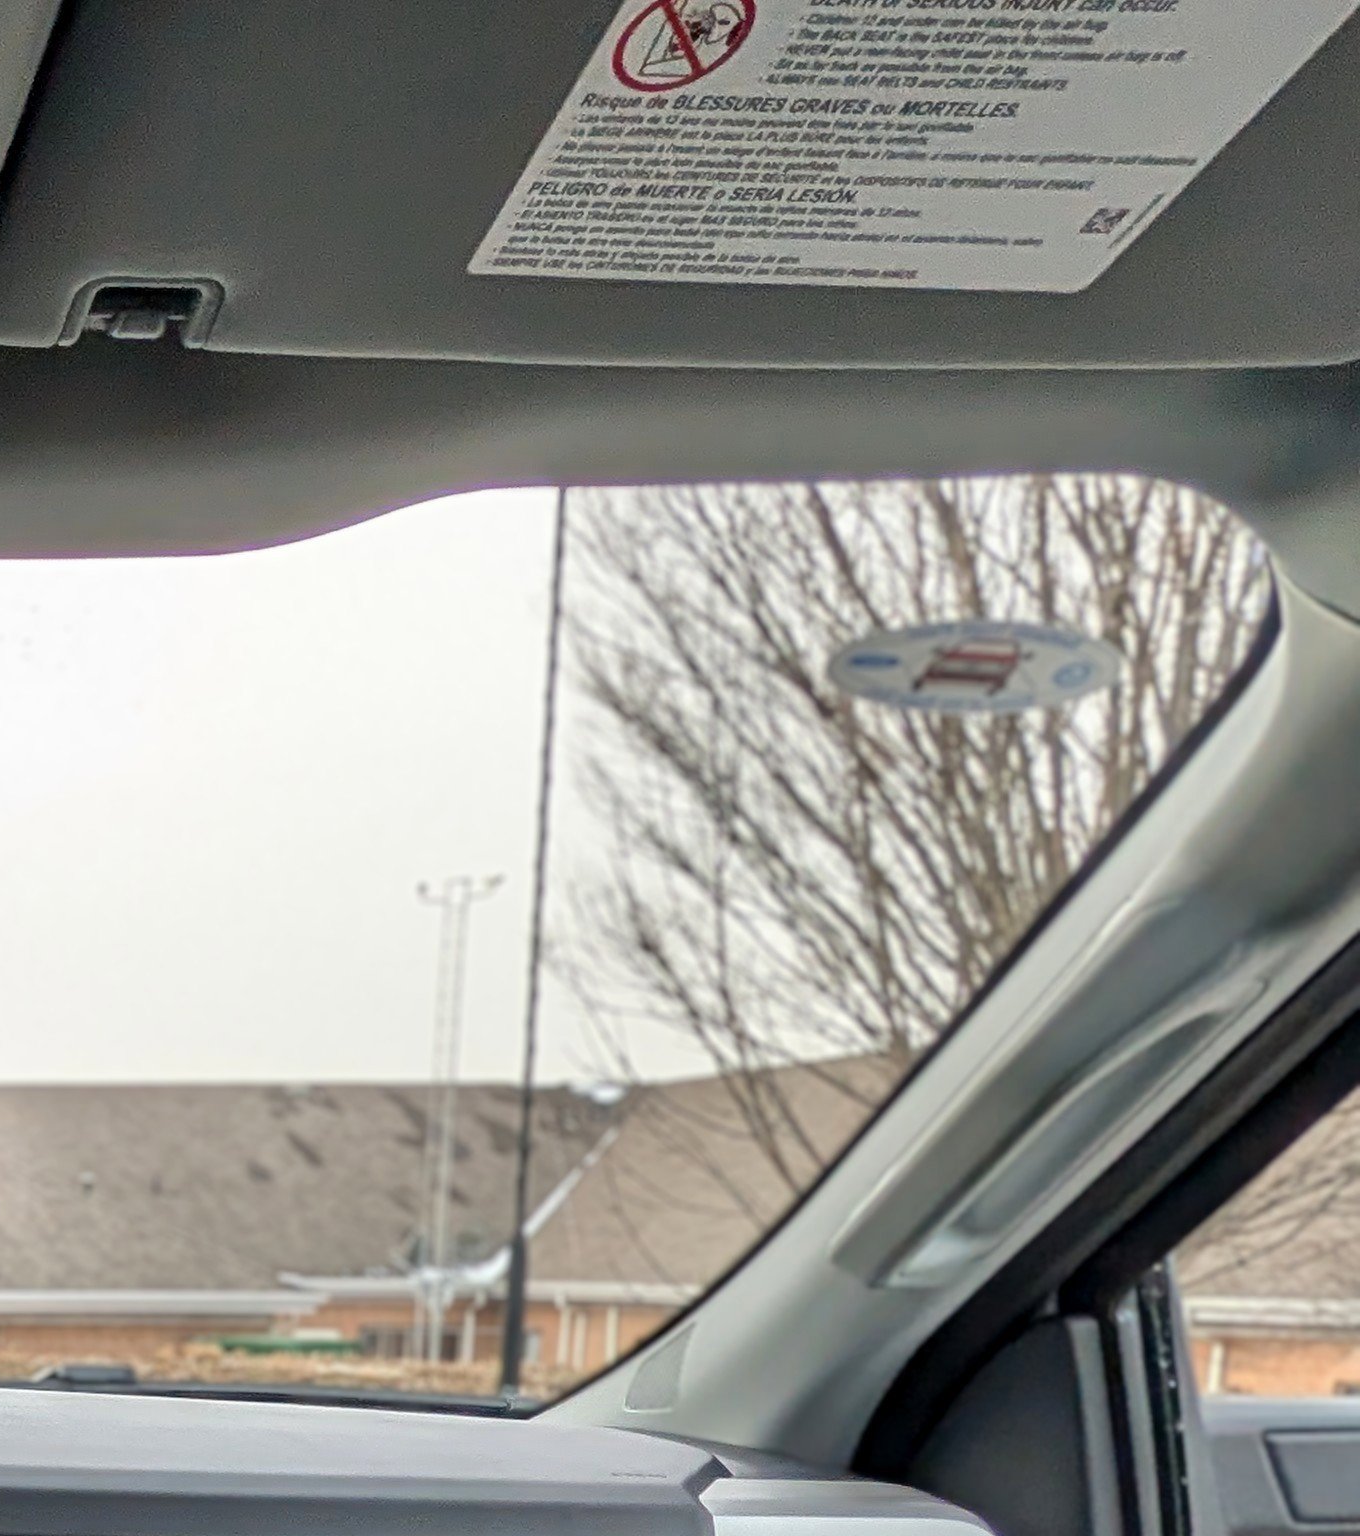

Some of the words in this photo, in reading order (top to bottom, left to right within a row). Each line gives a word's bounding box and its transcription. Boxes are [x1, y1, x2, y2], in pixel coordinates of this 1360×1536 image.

[581, 93, 642, 113] Risque
[646, 95, 669, 109] de
[672, 94, 788, 113] BLESSURES
[789, 98, 871, 115] GRAVES
[871, 103, 896, 115] ou
[527, 181, 608, 196] PELIGRO
[610, 184, 633, 197] de
[635, 184, 713, 200] MUERTE
[713, 189, 726, 200] o
[729, 187, 784, 202] SERIA
